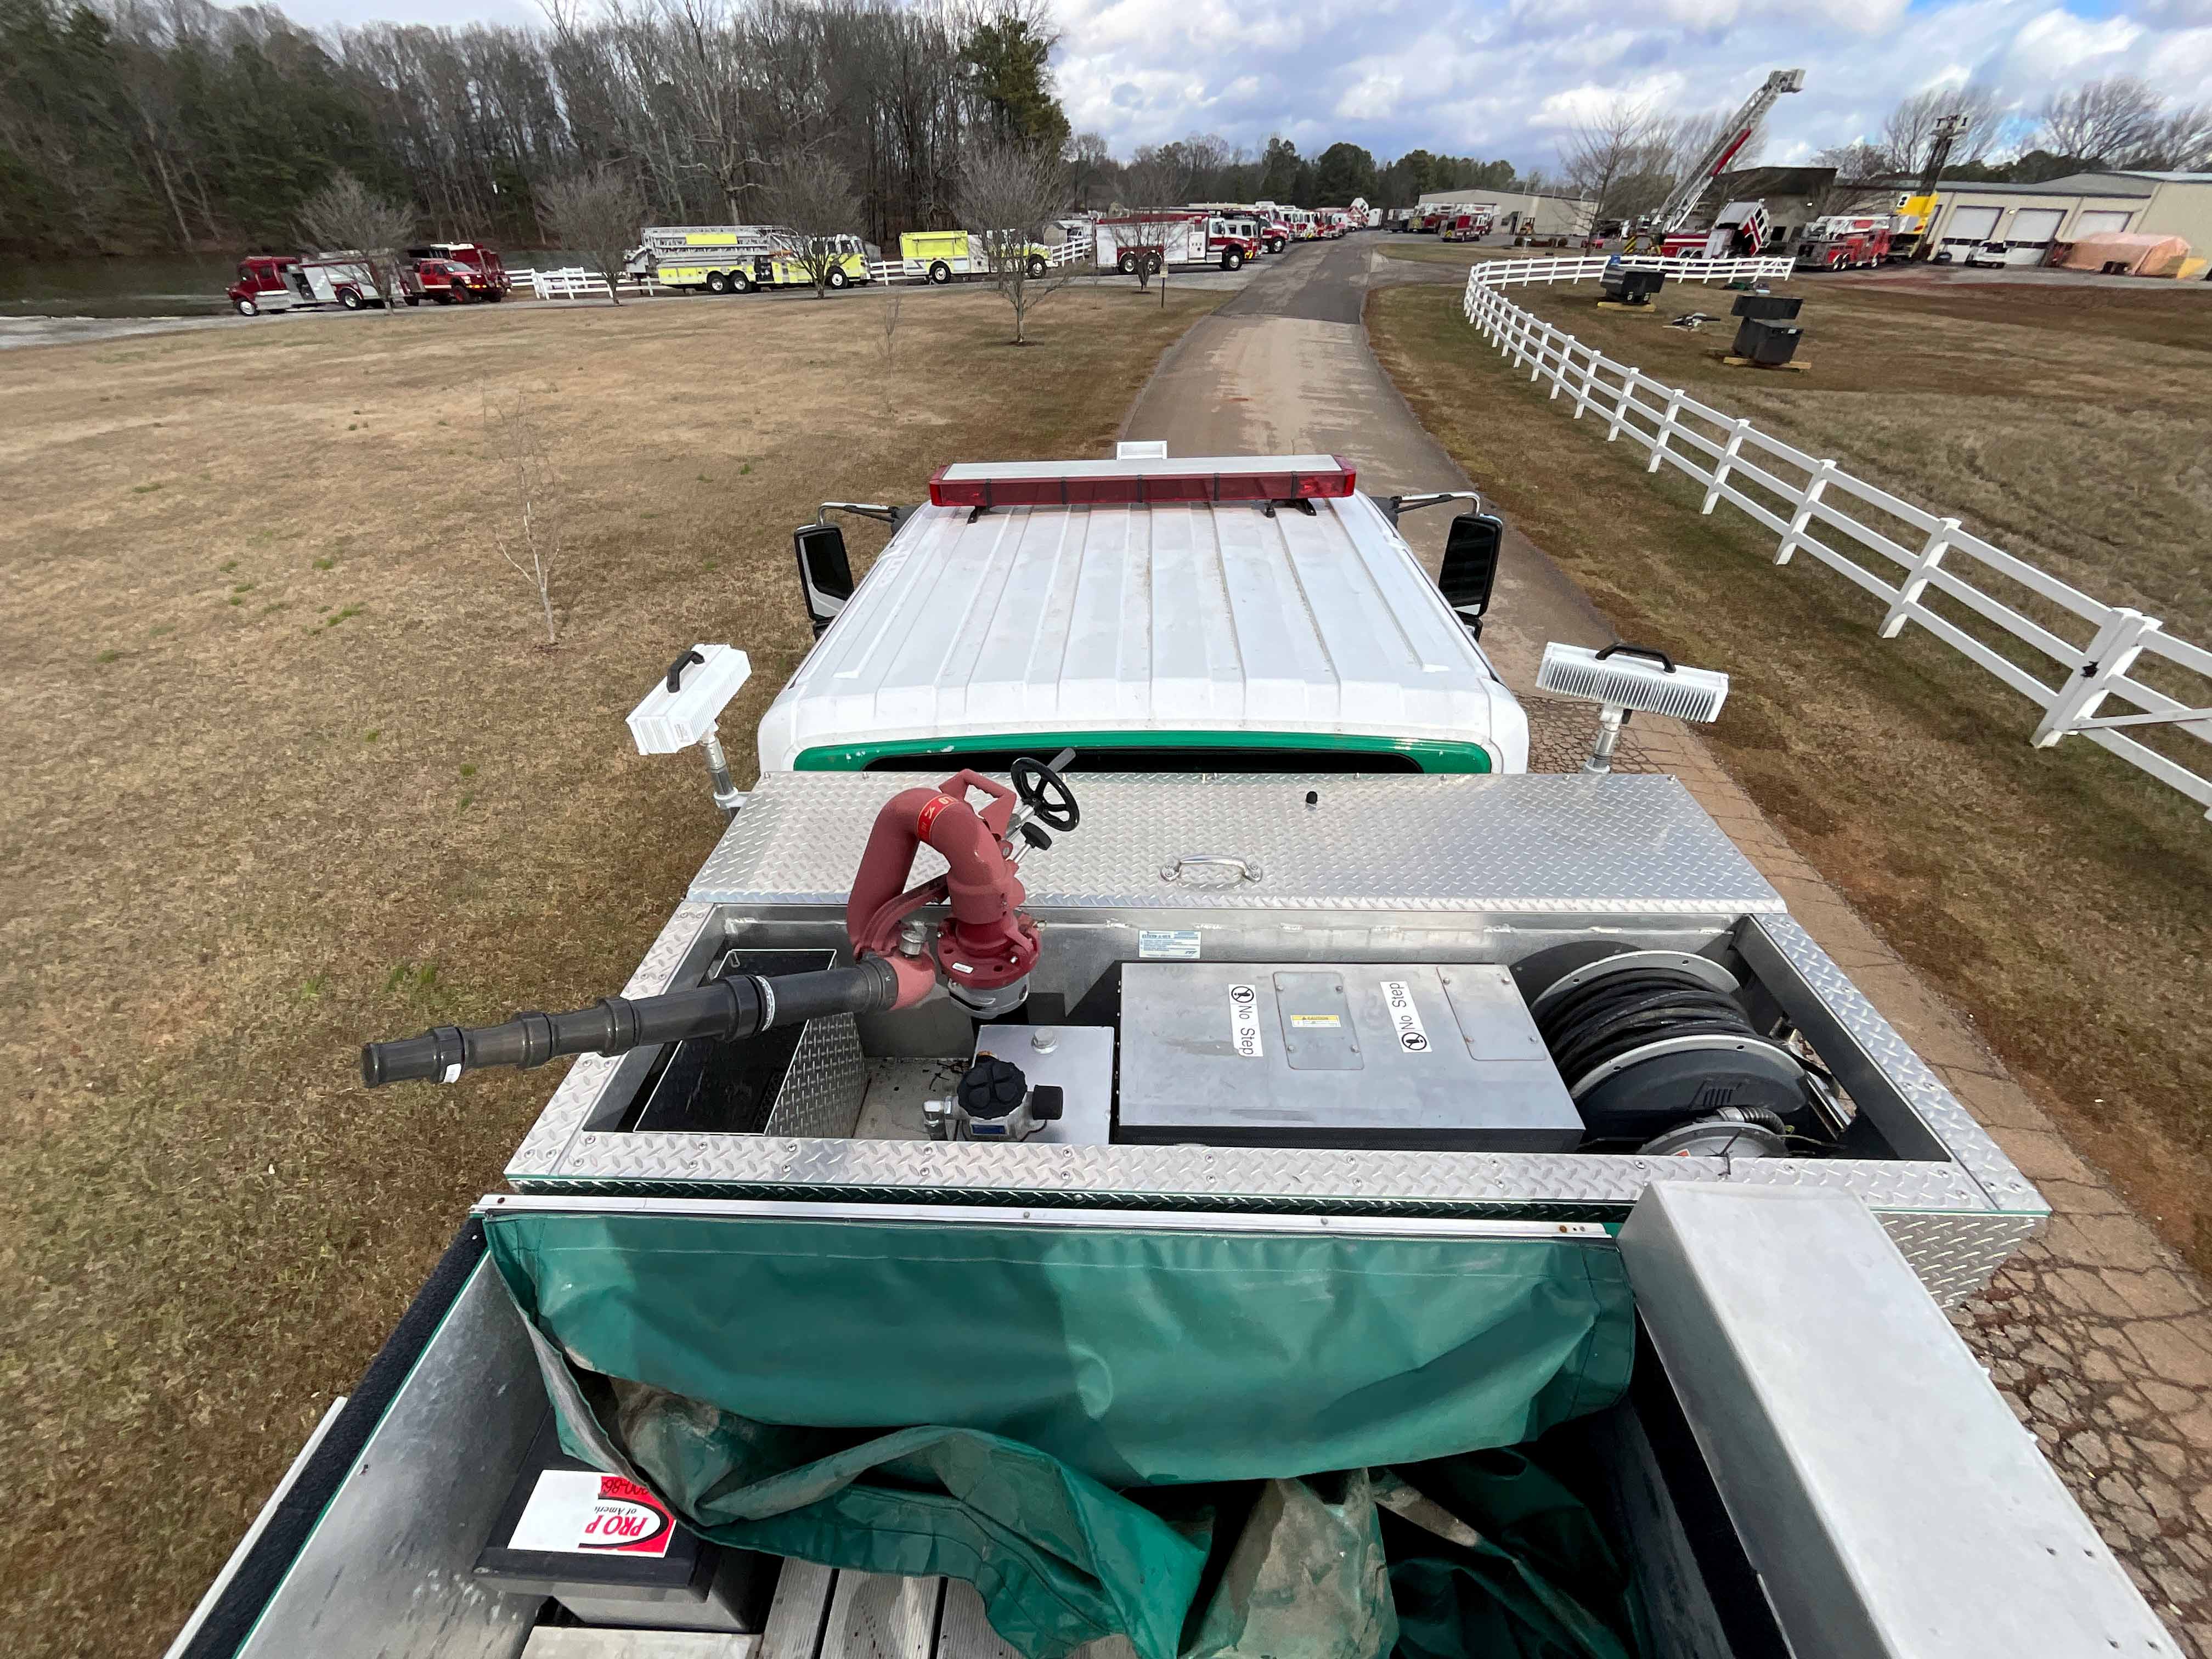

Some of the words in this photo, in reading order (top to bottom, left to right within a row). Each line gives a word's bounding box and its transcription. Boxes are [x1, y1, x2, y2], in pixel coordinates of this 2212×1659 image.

[1389, 983, 1407, 1007] Step
[1238, 1005, 1252, 1019] No
[1399, 1015, 1415, 1030] No
[1239, 1028, 1255, 1055] Step
[602, 1515, 648, 1537] PRO
